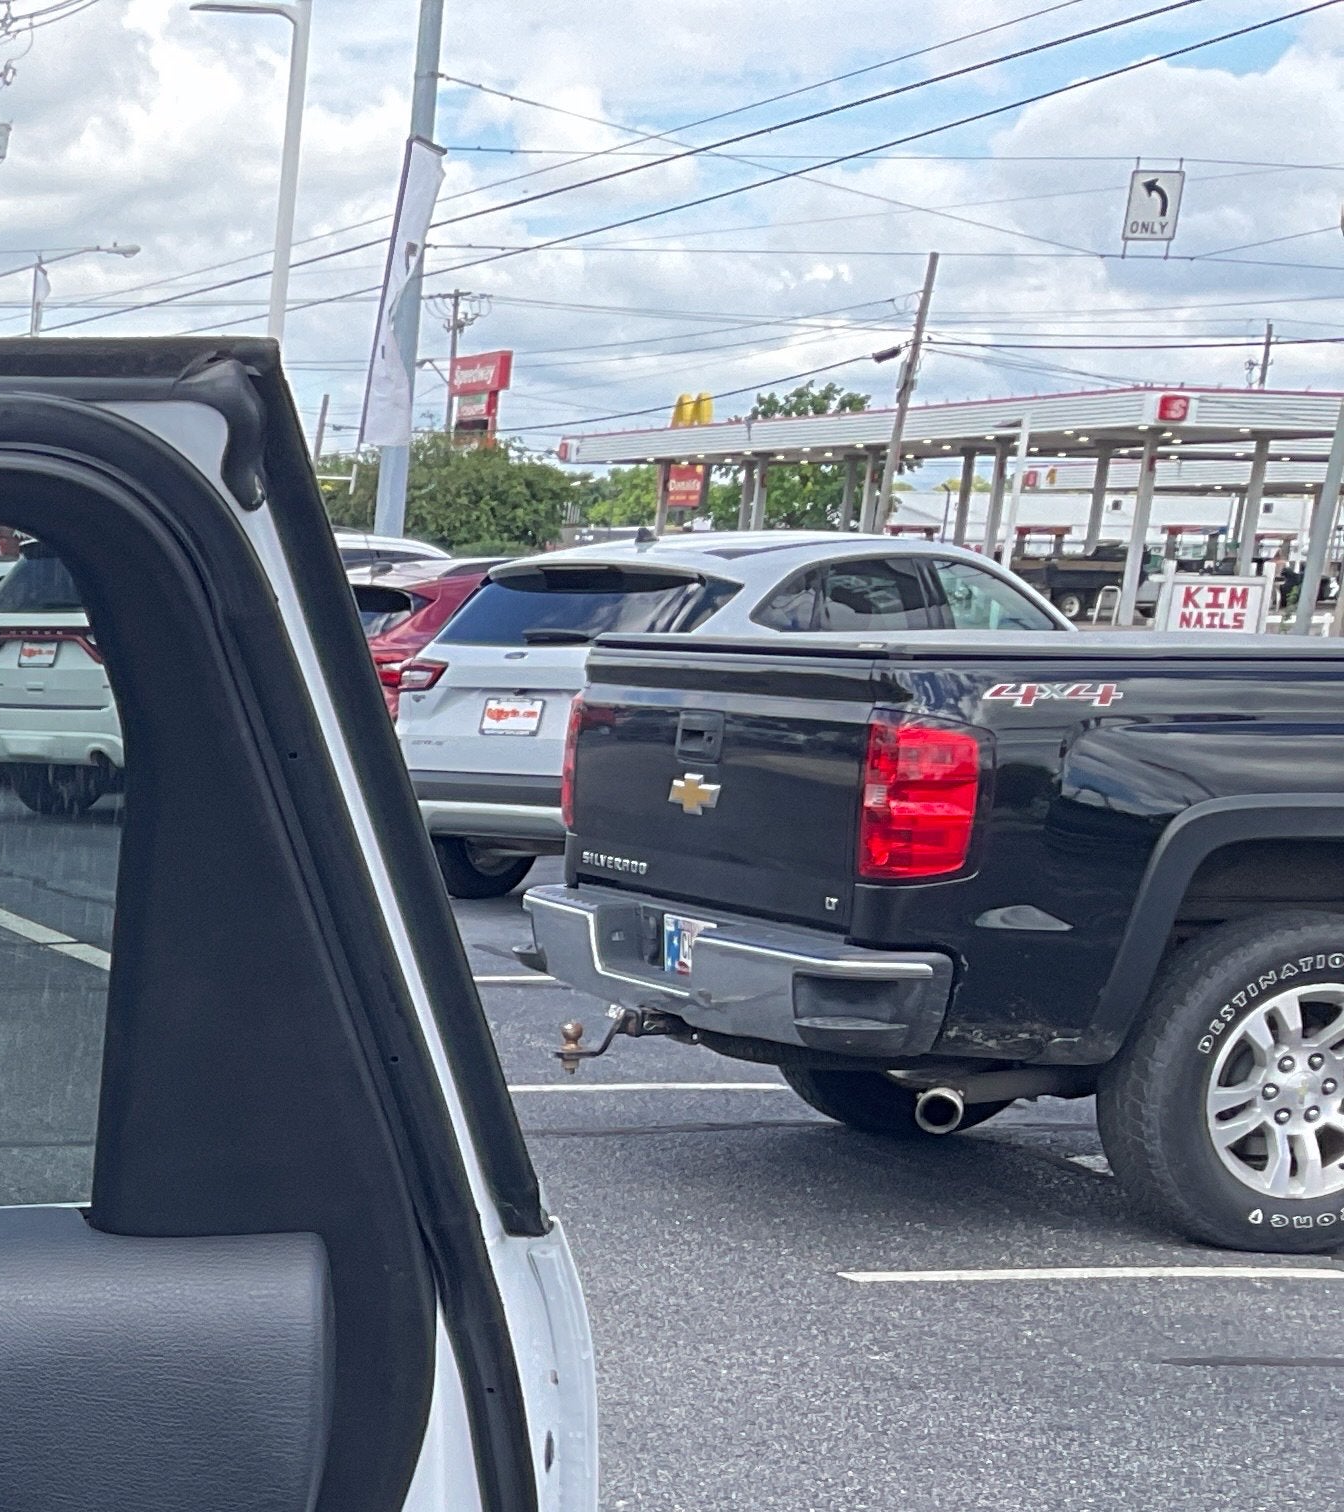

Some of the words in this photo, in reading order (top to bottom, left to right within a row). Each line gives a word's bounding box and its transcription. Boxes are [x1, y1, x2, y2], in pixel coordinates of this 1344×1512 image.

[1129, 220, 1169, 235] ONLY
[1181, 586, 1250, 610] KIM
[1178, 611, 1246, 630] NAILS
[582, 851, 647, 875] SILVERADO
[825, 896, 839, 911] LT
